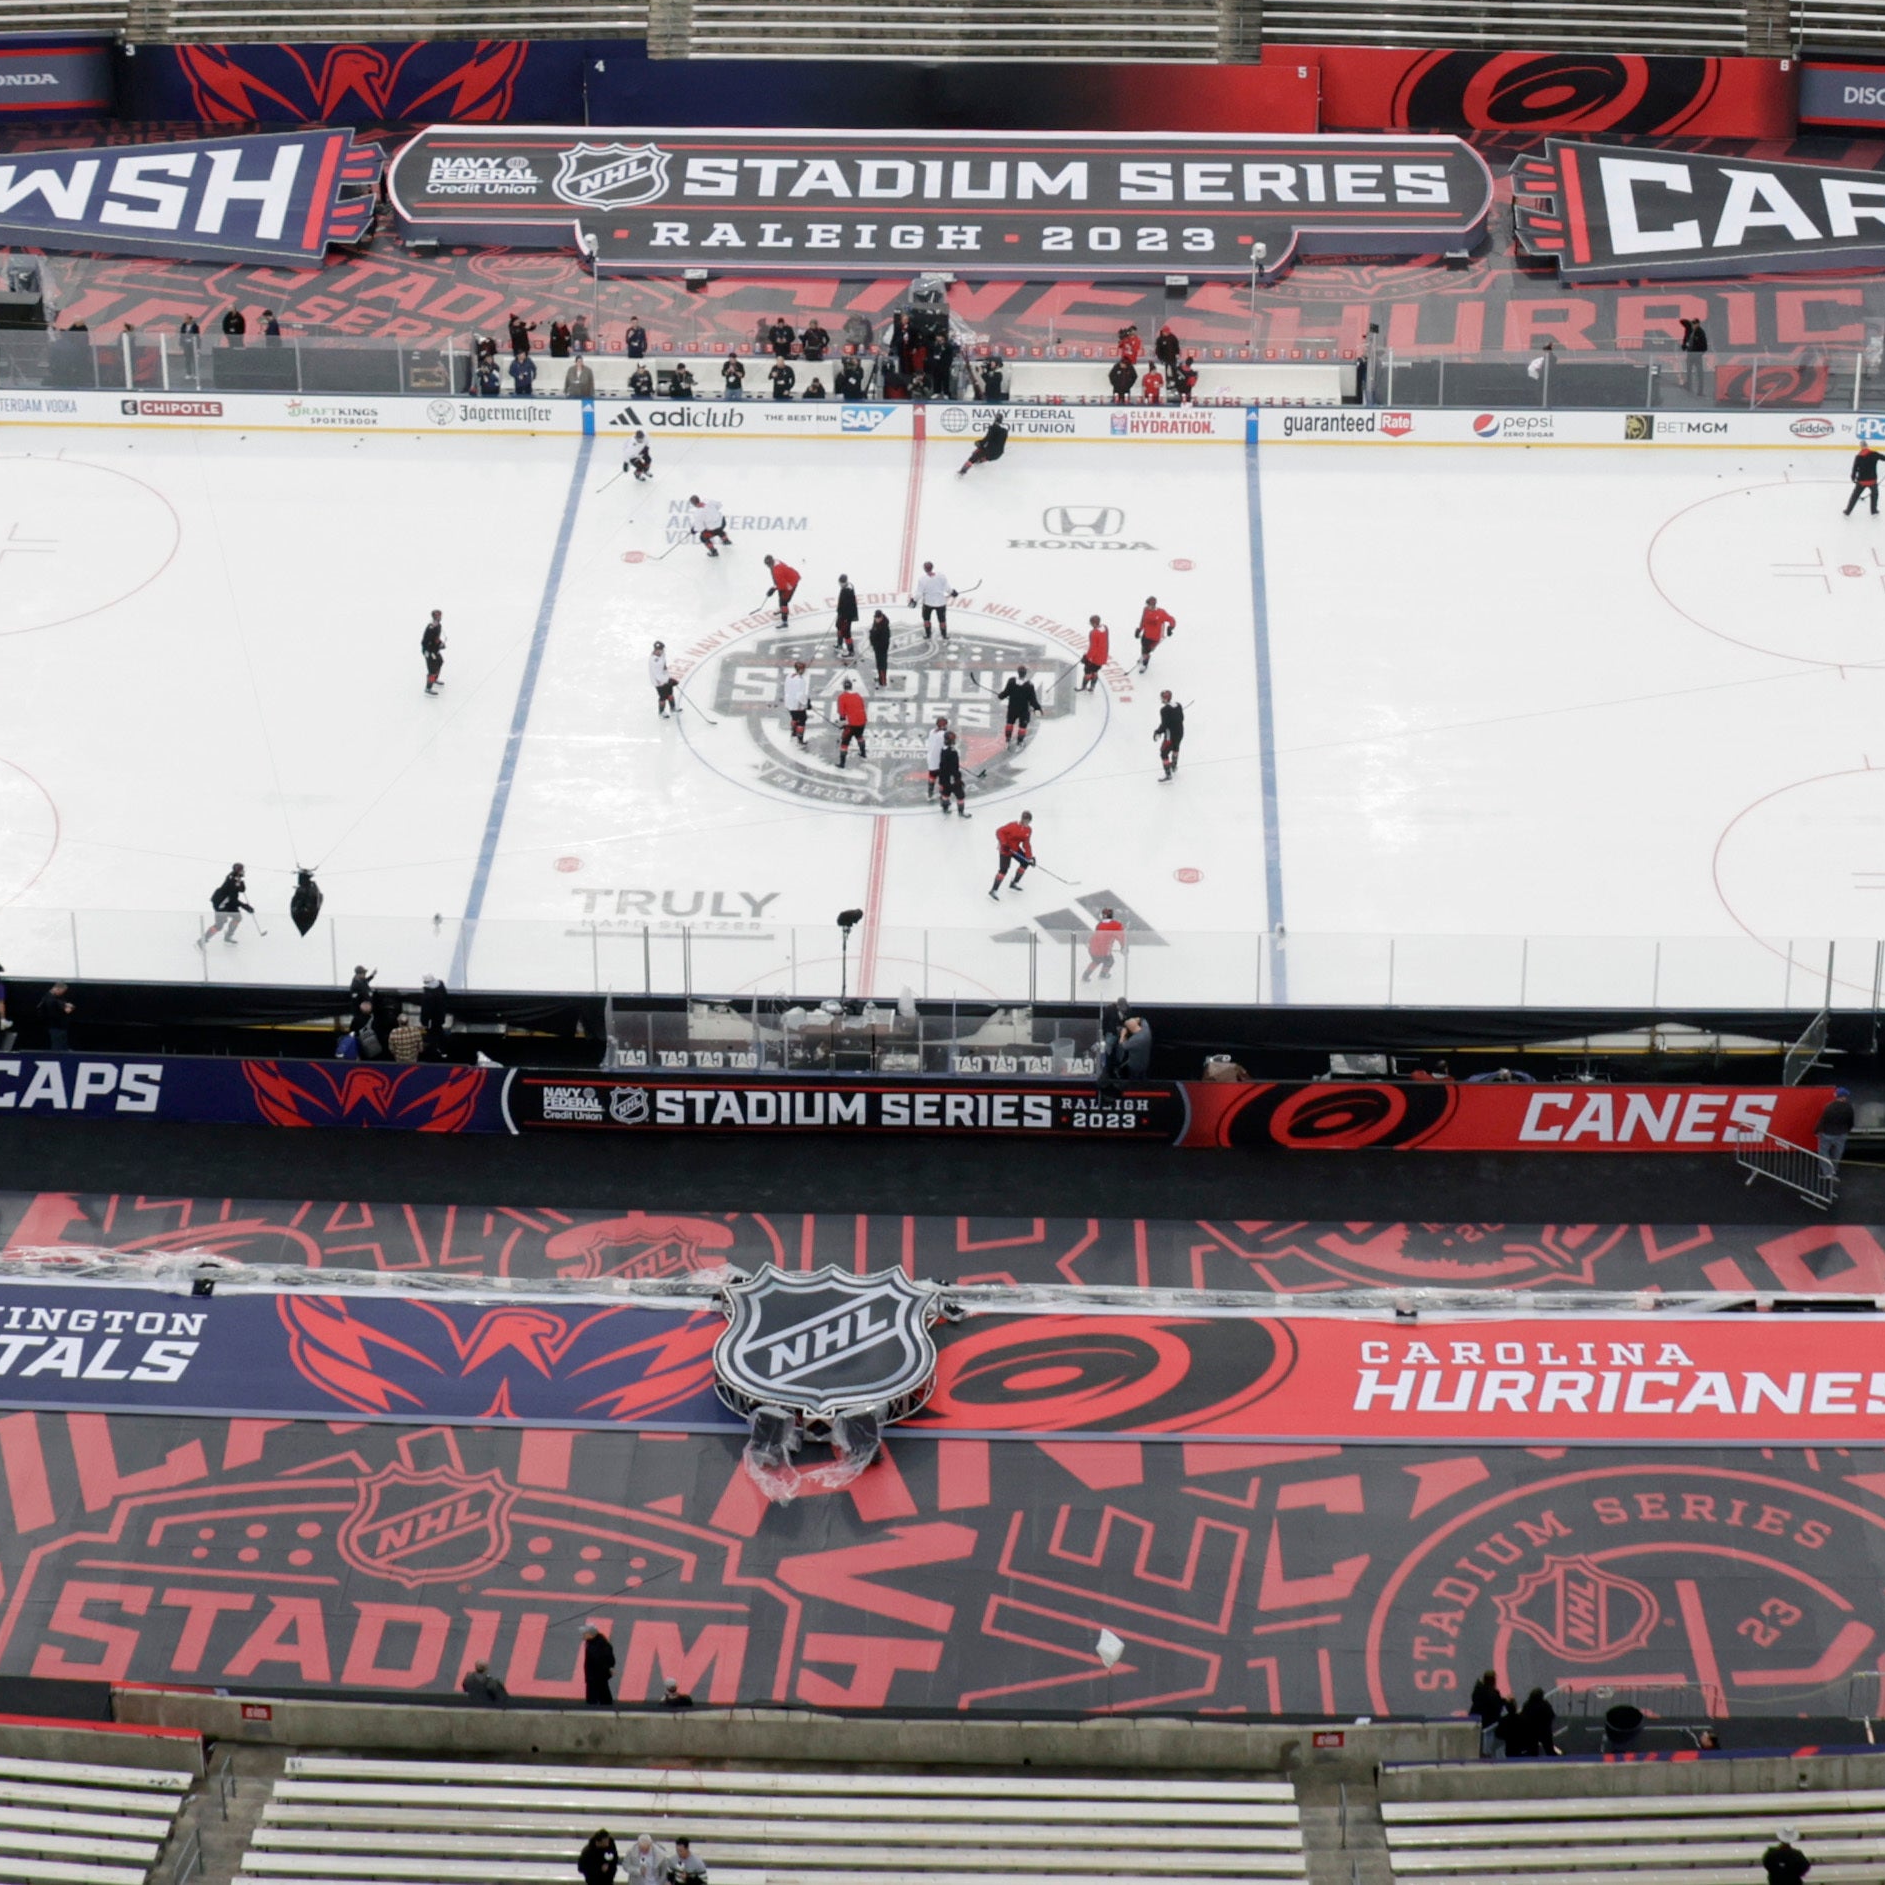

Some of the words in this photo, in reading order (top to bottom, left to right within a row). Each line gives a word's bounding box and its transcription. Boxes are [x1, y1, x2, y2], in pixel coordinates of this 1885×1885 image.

[126, 45, 135, 56] 3
[595, 61, 605, 71] 4
[1298, 67, 1307, 78] 5
[432, 157, 501, 170] NAVY
[428, 167, 543, 181] FEDERAL
[579, 158, 648, 196] NHL
[683, 159, 1088, 201] STADIUM
[1120, 161, 1451, 204] SERIES
[426, 181, 481, 195] Credit
[485, 182, 537, 195] Union
[650, 221, 982, 251] RALEIGH
[1042, 226, 1216, 251] 2023
[46, 399, 77, 413] VODKA
[143, 402, 221, 416] CHIPOTLE
[288, 405, 379, 418] DRAFTKINGS
[650, 406, 744, 428] adiclub
[842, 406, 884, 428] SAP
[972, 409, 1010, 419] NAVY
[1014, 409, 1075, 420] FEDERAL
[1131, 412, 1166, 420] CLEAN.
[1170, 412, 1215, 420] HEALTHY.
[1028, 423, 1076, 434] UNION
[1131, 419, 1216, 434] HYDRATION.
[1284, 414, 1376, 436] guaranteed
[1382, 414, 1410, 429] Rate
[1504, 415, 1553, 431] pepsi
[1657, 422, 1729, 434] BETMGM
[1790, 422, 1835, 434] Glidden
[1841, 424, 1853, 433] by
[1006, 538, 1158, 552] HONDA
[982, 602, 1022, 621] NHL
[564, 888, 781, 918] TRULY
[543, 1086, 581, 1098] NAVY
[543, 1096, 604, 1108] FEDERAL
[618, 1096, 643, 1114] NHL
[655, 1089, 866, 1126] STADIUM
[881, 1093, 1052, 1129] SERIES
[1060, 1097, 1149, 1112] RALEIGH
[543, 1108, 571, 1121] Credit
[574, 1108, 603, 1121] Union
[1072, 1112, 1136, 1128] 2023
[1518, 1092, 1778, 1142] CANES
[767, 1305, 886, 1376] NHL
[1361, 1340, 1697, 1369] CAROLINA
[376, 1488, 487, 1560] NHL
[1410, 1508, 1579, 1689] STADIUM
[1589, 1493, 1833, 1548] SERIES
[1566, 1580, 1599, 1650] NHL
[1734, 1595, 1804, 1651] 23
[37, 1583, 746, 1704] STADIUM
